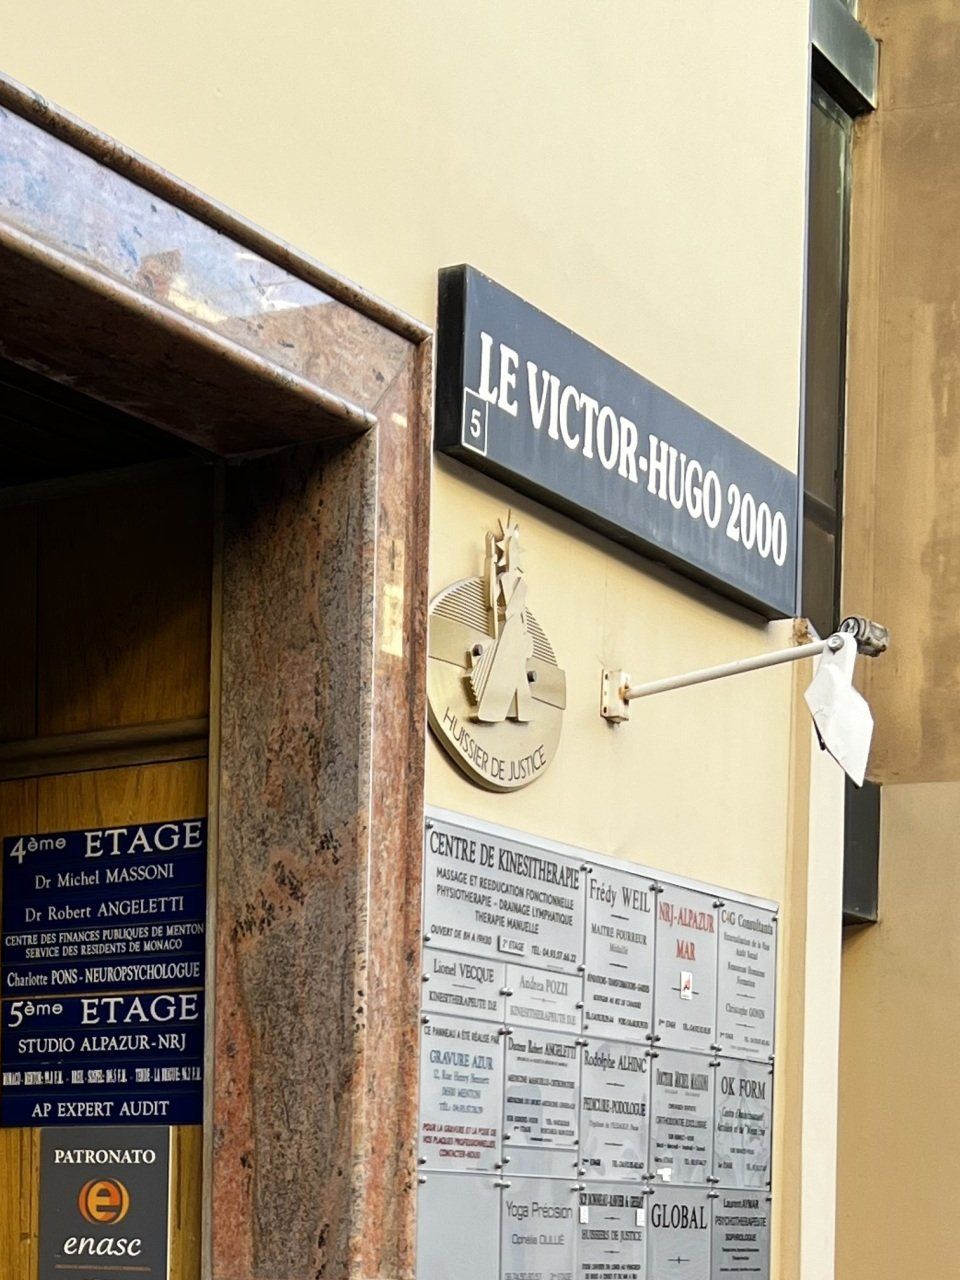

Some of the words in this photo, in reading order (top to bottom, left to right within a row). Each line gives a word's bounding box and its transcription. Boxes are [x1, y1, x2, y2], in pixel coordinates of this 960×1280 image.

[470, 409, 481, 438] 5
[478, 331, 519, 417] LE
[527, 360, 722, 529] VICTOR-HUGO
[726, 483, 787, 567] 2000
[443, 706, 489, 773] HUISSIER
[491, 757, 505, 780] DE
[508, 744, 546, 781] JUSTICE
[9, 837, 67, 864] 4ème
[84, 821, 203, 857] ETAGE
[430, 830, 476, 863] CENTRE
[480, 844, 495, 868] DE
[498, 848, 580, 890] KINESITHERAPIE
[35, 875, 52, 889] Dr
[57, 870, 100, 887] Michel
[106, 863, 174, 883] MASSONI
[436, 867, 467, 885] MASSAGE
[469, 874, 478, 886] ET
[479, 877, 524, 897] REEDUCATION
[526, 888, 574, 910] FONCTIONNELLE
[436, 884, 492, 907] PHYSIOTHERAPIE
[499, 899, 530, 916] DRAINAGE
[532, 906, 573, 926] LYMPHATIQUE
[590, 878, 617, 908] Frédy
[621, 886, 651, 913] WEIL
[25, 907, 42, 922] Dr
[48, 905, 91, 921] Robert
[97, 896, 184, 917] ANGELETTI
[5, 934, 38, 947] CENTRE
[40, 932, 56, 945] DES
[59, 930, 100, 944] FINANCES
[102, 926, 149, 941] PUBLIQUES
[151, 925, 163, 938] DE
[166, 922, 204, 936] MENTON
[430, 924, 453, 937] OUVERT
[475, 910, 505, 927] THERAPIE
[507, 918, 539, 934] MANUELLE
[25, 947, 59, 959] SERVICE
[62, 945, 79, 957] DES
[81, 942, 126, 956] RESIDENTS
[129, 940, 141, 952] DE
[143, 938, 182, 951] MONACO
[676, 939, 696, 962] MAR
[7, 972, 48, 987] Charlotte
[51, 969, 78, 985] PONS
[85, 962, 200, 984] NEUROPSYCHOLOGUE
[433, 957, 457, 977] Lionel
[459, 964, 495, 983] VECQUE
[545, 979, 568, 996] POZZI
[8, 1000, 63, 1027] 5ème
[81, 994, 199, 1025] ETAGE
[18, 1037, 75, 1053] STUDIO
[429, 1050, 469, 1067] GRAVURE
[472, 1055, 494, 1070] AZUR
[721, 1076, 735, 1096] OK
[738, 1078, 766, 1100] FORM
[32, 1103, 52, 1118] AP
[57, 1102, 114, 1117] EXPERT
[119, 1101, 170, 1116] AUDIT
[54, 1149, 156, 1164] PATRONATO
[506, 1201, 529, 1221] Yoga
[532, 1201, 572, 1219] Précision
[651, 1203, 708, 1230] GLOBAL
[63, 1236, 142, 1257] enasc
